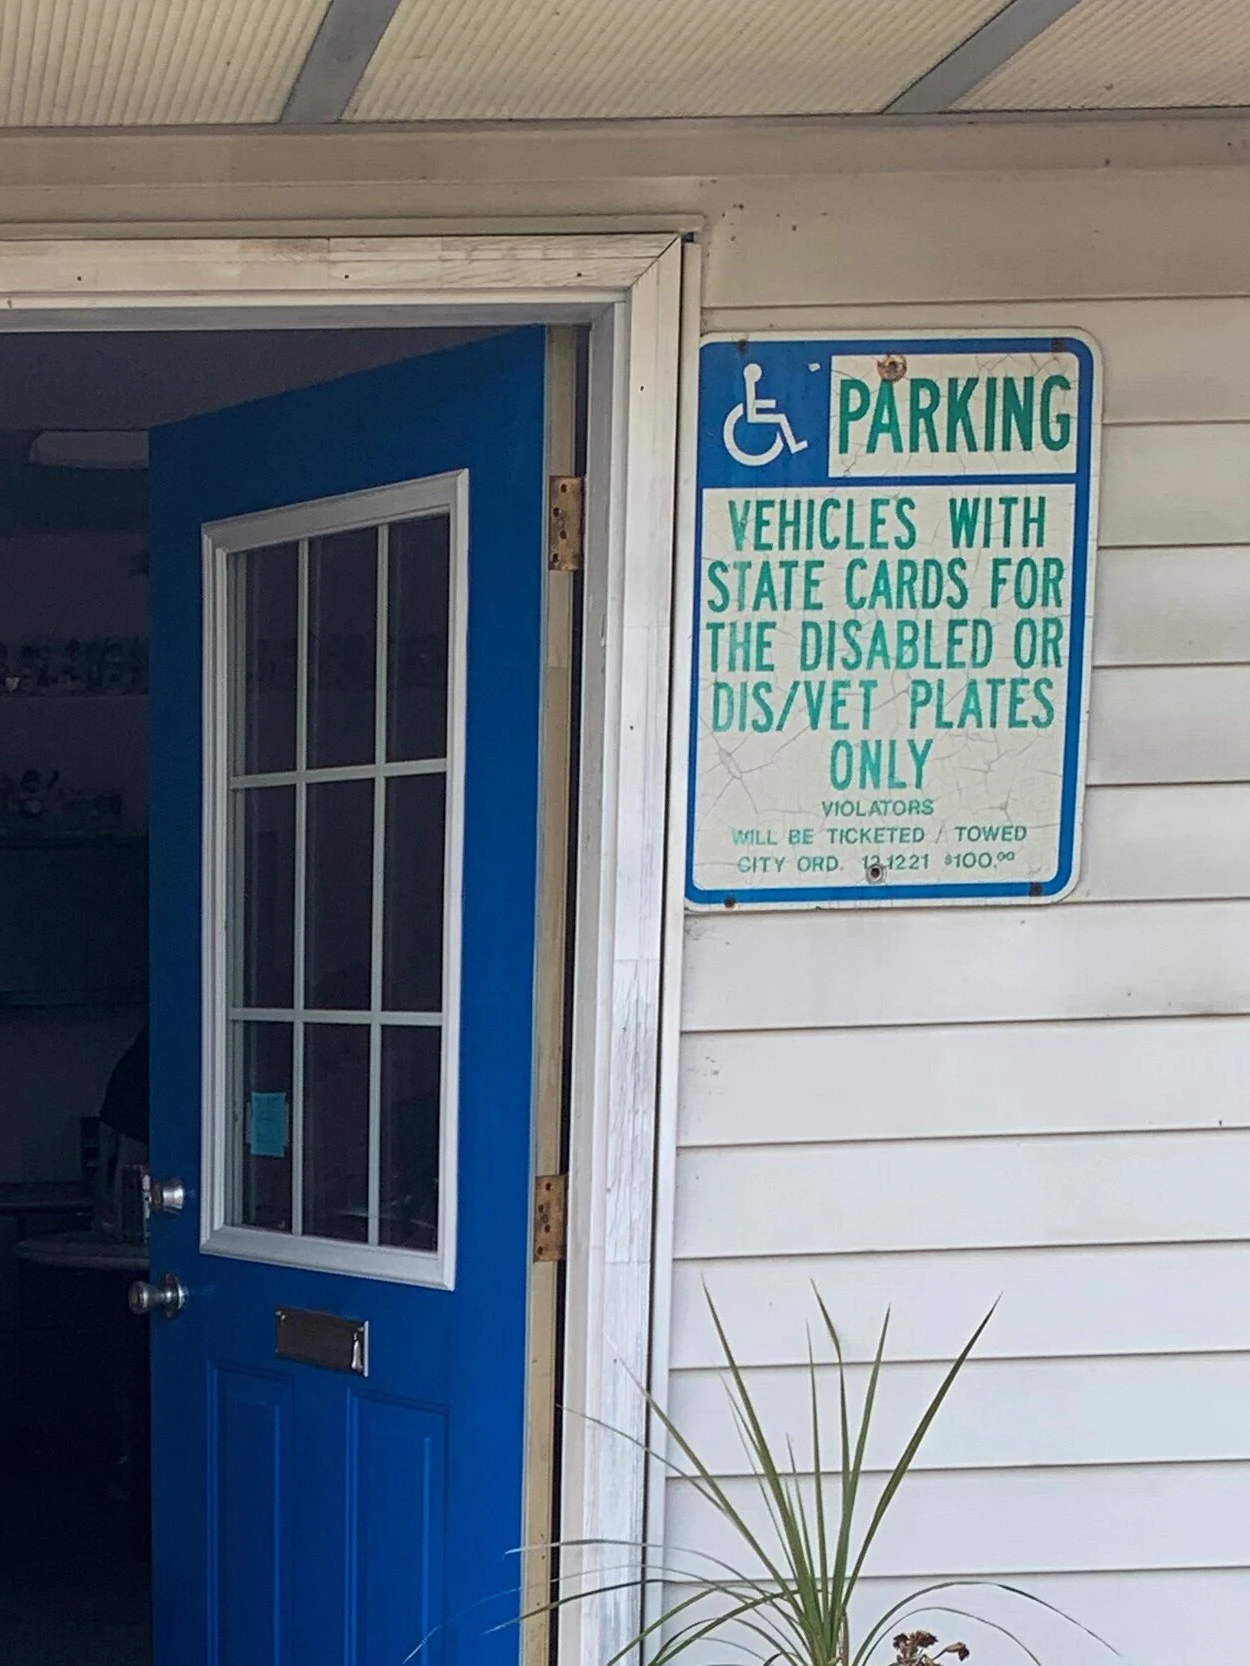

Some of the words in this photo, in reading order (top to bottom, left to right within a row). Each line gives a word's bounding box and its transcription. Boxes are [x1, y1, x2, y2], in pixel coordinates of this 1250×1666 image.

[838, 374, 1071, 454] PARKING
[729, 496, 916, 552] VEHICLES
[949, 495, 1046, 549] WITH
[707, 559, 825, 613] STATE
[845, 557, 969, 611] CARDS
[991, 556, 1064, 610] FOR
[706, 621, 777, 673] THE
[800, 618, 994, 672] DISABLED
[1013, 617, 1064, 670] OR
[711, 679, 878, 733] DIS/VET
[910, 677, 1055, 730] PLATES
[829, 738, 933, 791] ONLY
[732, 828, 777, 845] WILL
[788, 828, 814, 845] BE
[828, 826, 925, 844] TICKETED
[955, 825, 1027, 842] TOWED
[821, 800, 934, 817] VIOLATORS
[737, 856, 785, 873] CITY
